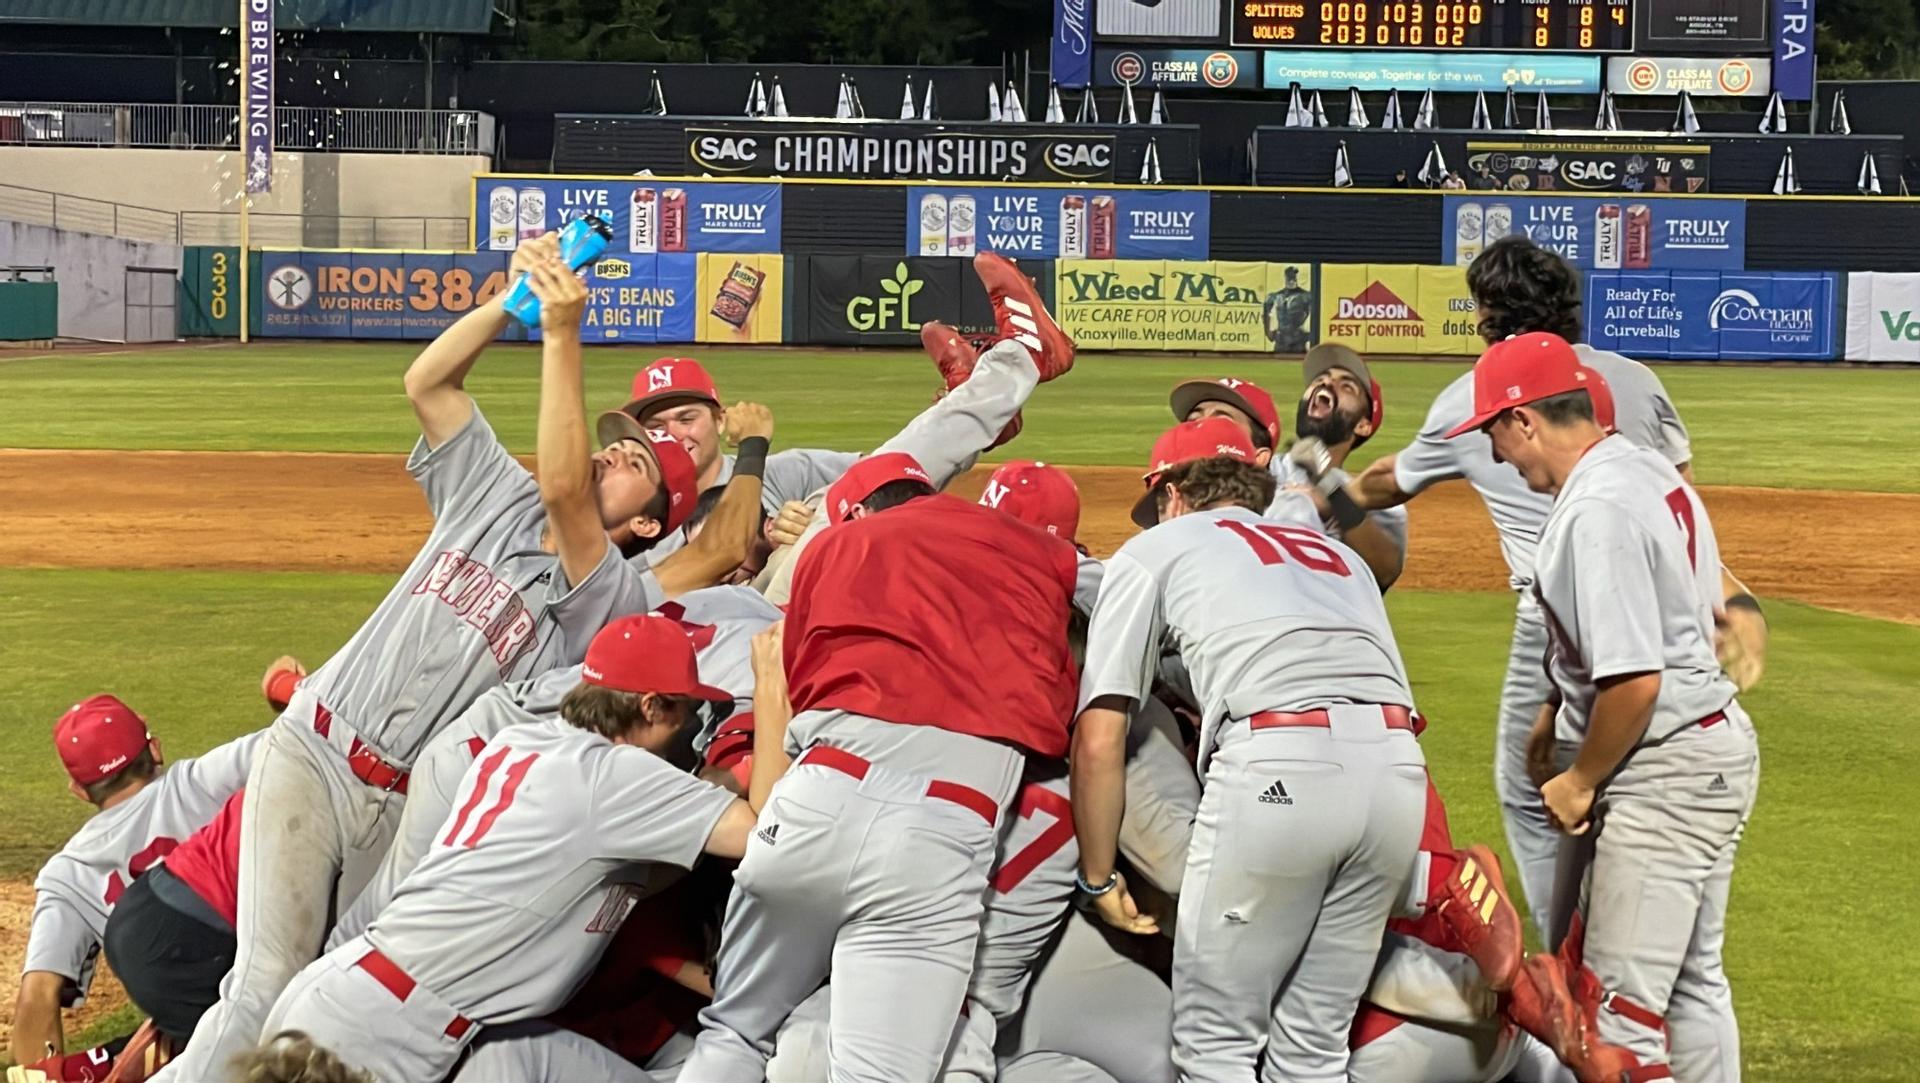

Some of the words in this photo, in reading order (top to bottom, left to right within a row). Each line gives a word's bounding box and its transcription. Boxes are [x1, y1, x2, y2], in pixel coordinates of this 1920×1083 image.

[1244, 5, 1304, 18] SPLITTERS
[1536, 7, 1548, 24] 4
[1580, 7, 1593, 26] 8
[1611, 8, 1624, 25] 4
[1253, 26, 1295, 39] WOLVES
[1535, 28, 1548, 47] 8
[1580, 28, 1592, 47] 8
[1151, 61, 1183, 72] CLASS
[1183, 62, 1198, 72] AA
[1279, 66, 1329, 79] Complete
[1331, 68, 1380, 80] coverage.
[1381, 69, 1425, 81] Together
[1428, 71, 1443, 81] for
[1444, 72, 1461, 81] the
[1464, 73, 1485, 82] win.
[1666, 69, 1698, 79] CLASS
[1699, 69, 1713, 79] AA
[252, 21, 268, 137] BREWING
[1151, 72, 1198, 82] AFFILIATE
[1666, 79, 1713, 90] AFFILIATE
[700, 137, 758, 161] SAC
[775, 136, 1027, 176] CHAMPIONSHIPS
[1053, 143, 1111, 168] SAC
[1568, 161, 1617, 181] SAC
[563, 188, 609, 206] LIVE
[993, 196, 1038, 213] LIVE
[700, 203, 767, 221] TRULY
[1129, 210, 1195, 228] TRULY
[1529, 205, 1574, 222] LIVE
[635, 204, 647, 246] TRULY
[987, 215, 1043, 232] YOUR
[1065, 211, 1076, 253] TRULY
[1523, 224, 1579, 241] YOUR
[1665, 219, 1730, 236] TRULY
[987, 234, 1043, 251] WAVE
[1600, 220, 1611, 262] TRULY
[597, 264, 629, 275] BUSH'S
[211, 252, 227, 319] 330
[318, 266, 406, 294] IRON
[409, 267, 508, 312] 384
[1059, 268, 1166, 303] Weed
[1171, 271, 1263, 304] Man
[319, 297, 405, 311] WORKERS
[619, 287, 675, 307] BEANS
[1449, 298, 1477, 312] INS
[1606, 288, 1650, 304] Ready
[1652, 289, 1676, 303] For
[846, 280, 923, 331] GFL
[1604, 306, 1625, 319] All
[1629, 306, 1645, 319] of
[1648, 306, 1683, 321] Life's
[1721, 302, 1813, 322] Covenant
[586, 308, 599, 326] A
[603, 308, 631, 326] BIG
[636, 308, 664, 327] HIT
[1064, 308, 1088, 322] WE
[1092, 308, 1132, 323] CARE
[1136, 309, 1166, 323] FOR
[1171, 309, 1212, 324] YOUR
[1216, 310, 1260, 325] LAWN
[1769, 321, 1813, 330] HEALTH
[1073, 328, 1250, 343] Knoxville.WeedMan.com
[1329, 324, 1361, 337] PEST
[1367, 324, 1426, 338] CONTROL
[1604, 324, 1681, 338] Curveballs
[647, 366, 674, 393] N
[977, 479, 1011, 508] N
[1215, 518, 1352, 578] 16
[443, 745, 541, 850] 11
[1258, 795, 1293, 805] adidas
[989, 783, 1076, 896] 7
